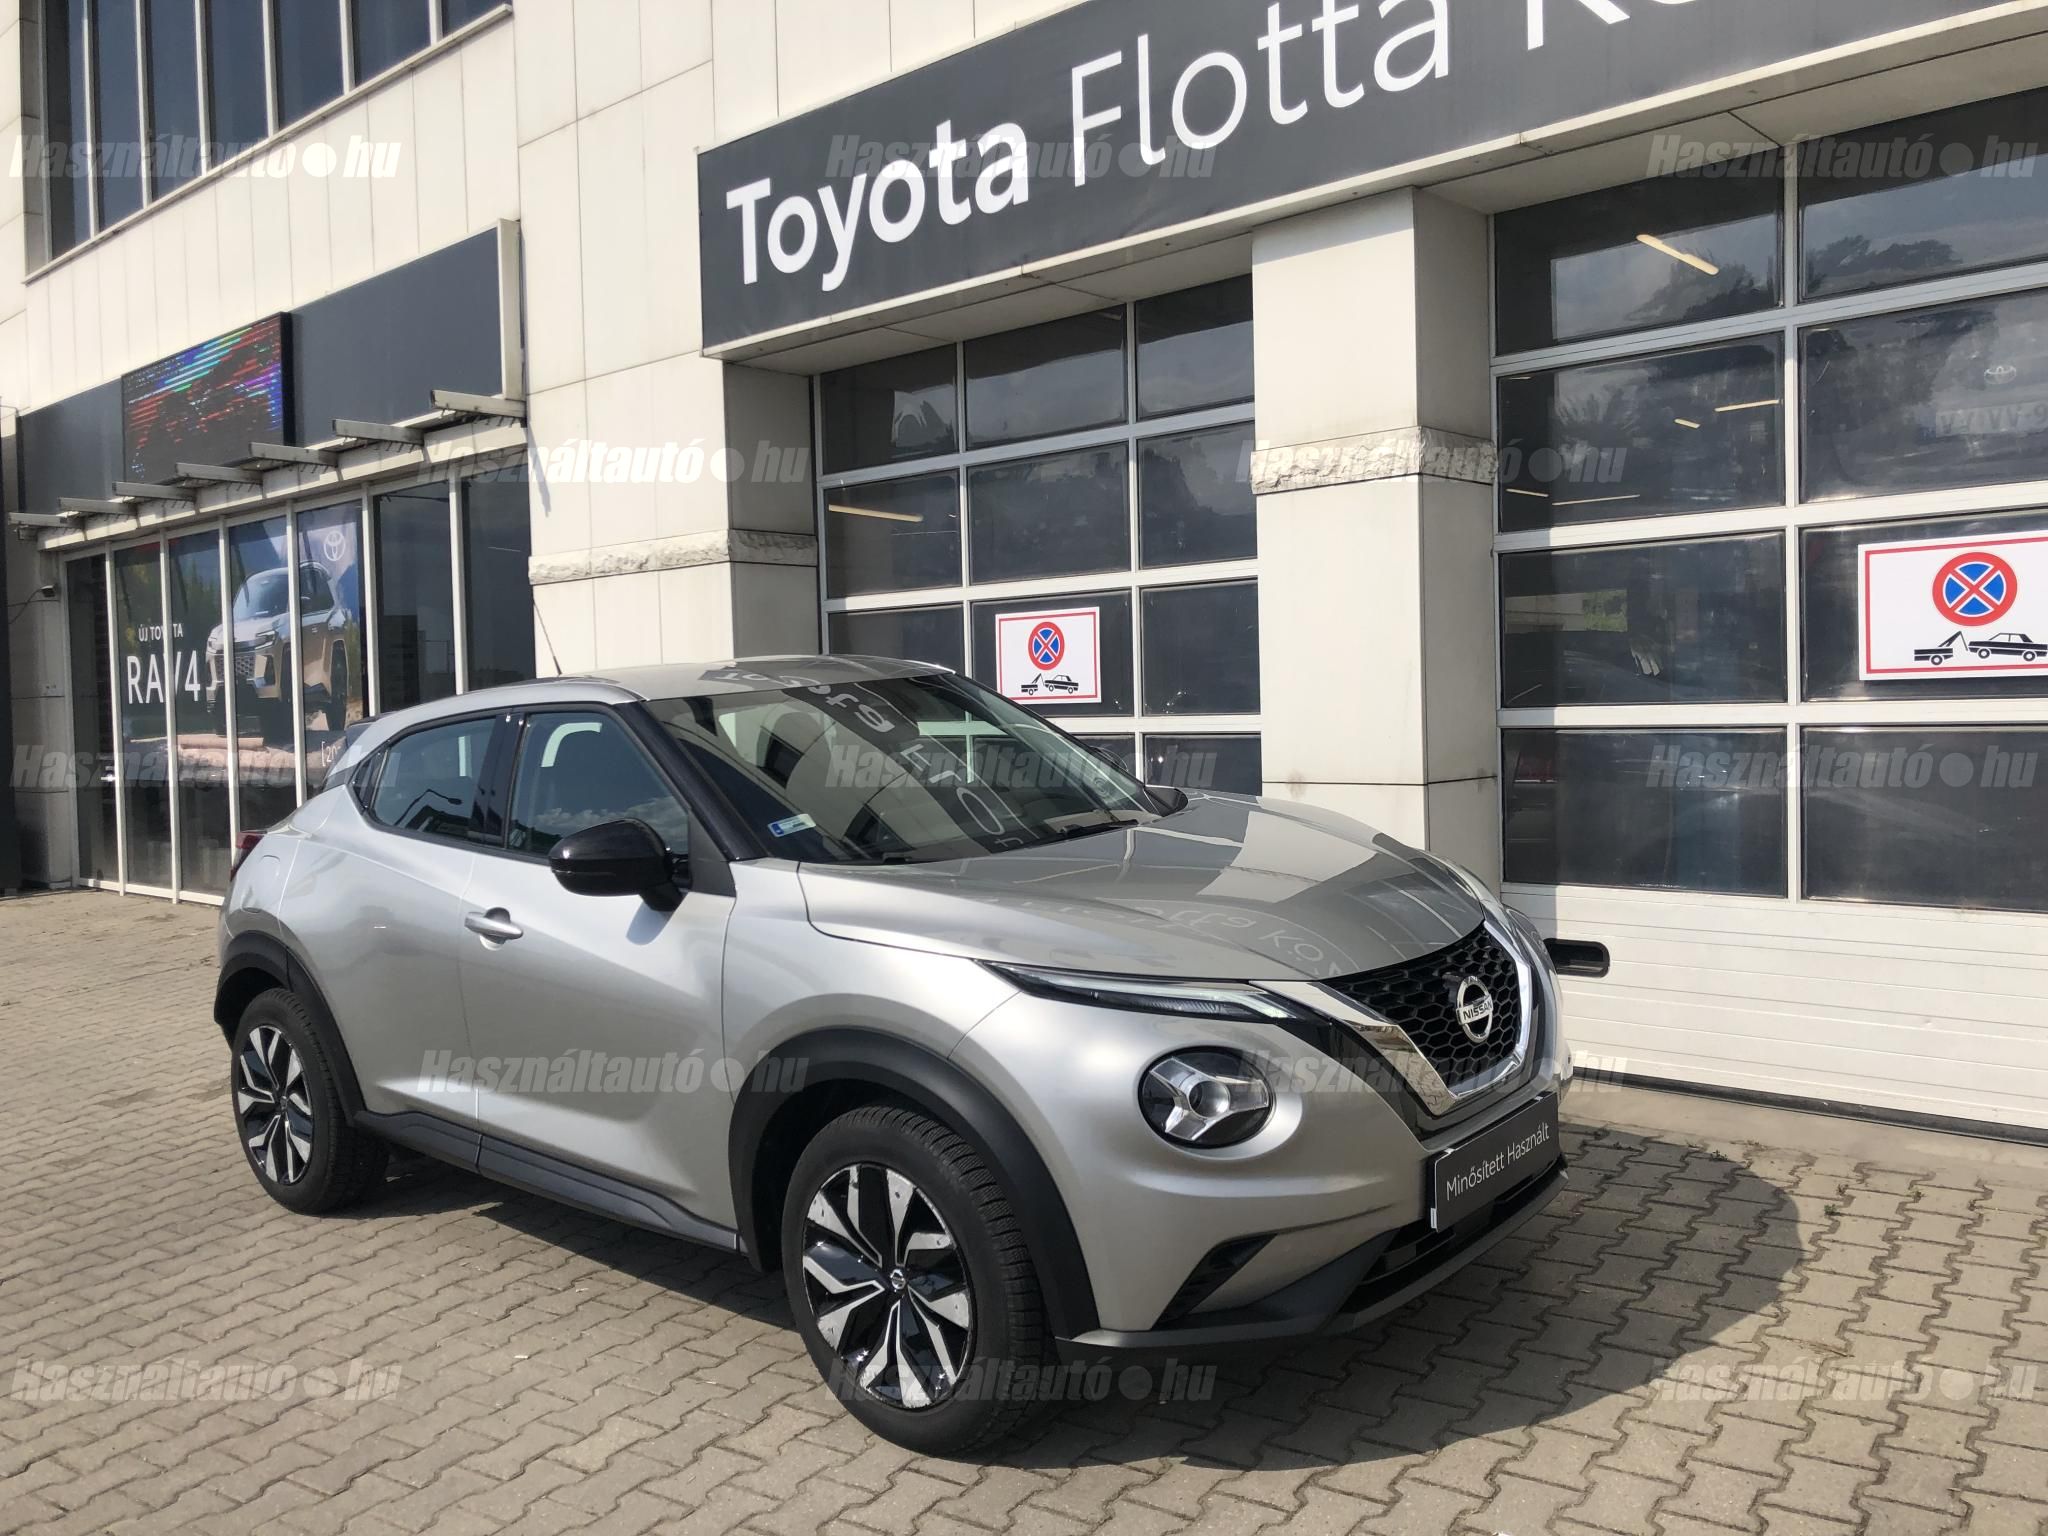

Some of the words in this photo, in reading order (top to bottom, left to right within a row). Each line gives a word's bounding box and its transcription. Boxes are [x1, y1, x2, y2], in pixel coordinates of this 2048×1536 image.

[726, 120, 1029, 292] Toyota
[1071, 0, 1450, 187] Flotta
[138, 623, 149, 642] ÚJ
[1463, 999, 1493, 1021] NISSAN
[1446, 1151, 1505, 1201] Minősített
[1507, 1121, 1550, 1166] Használt
